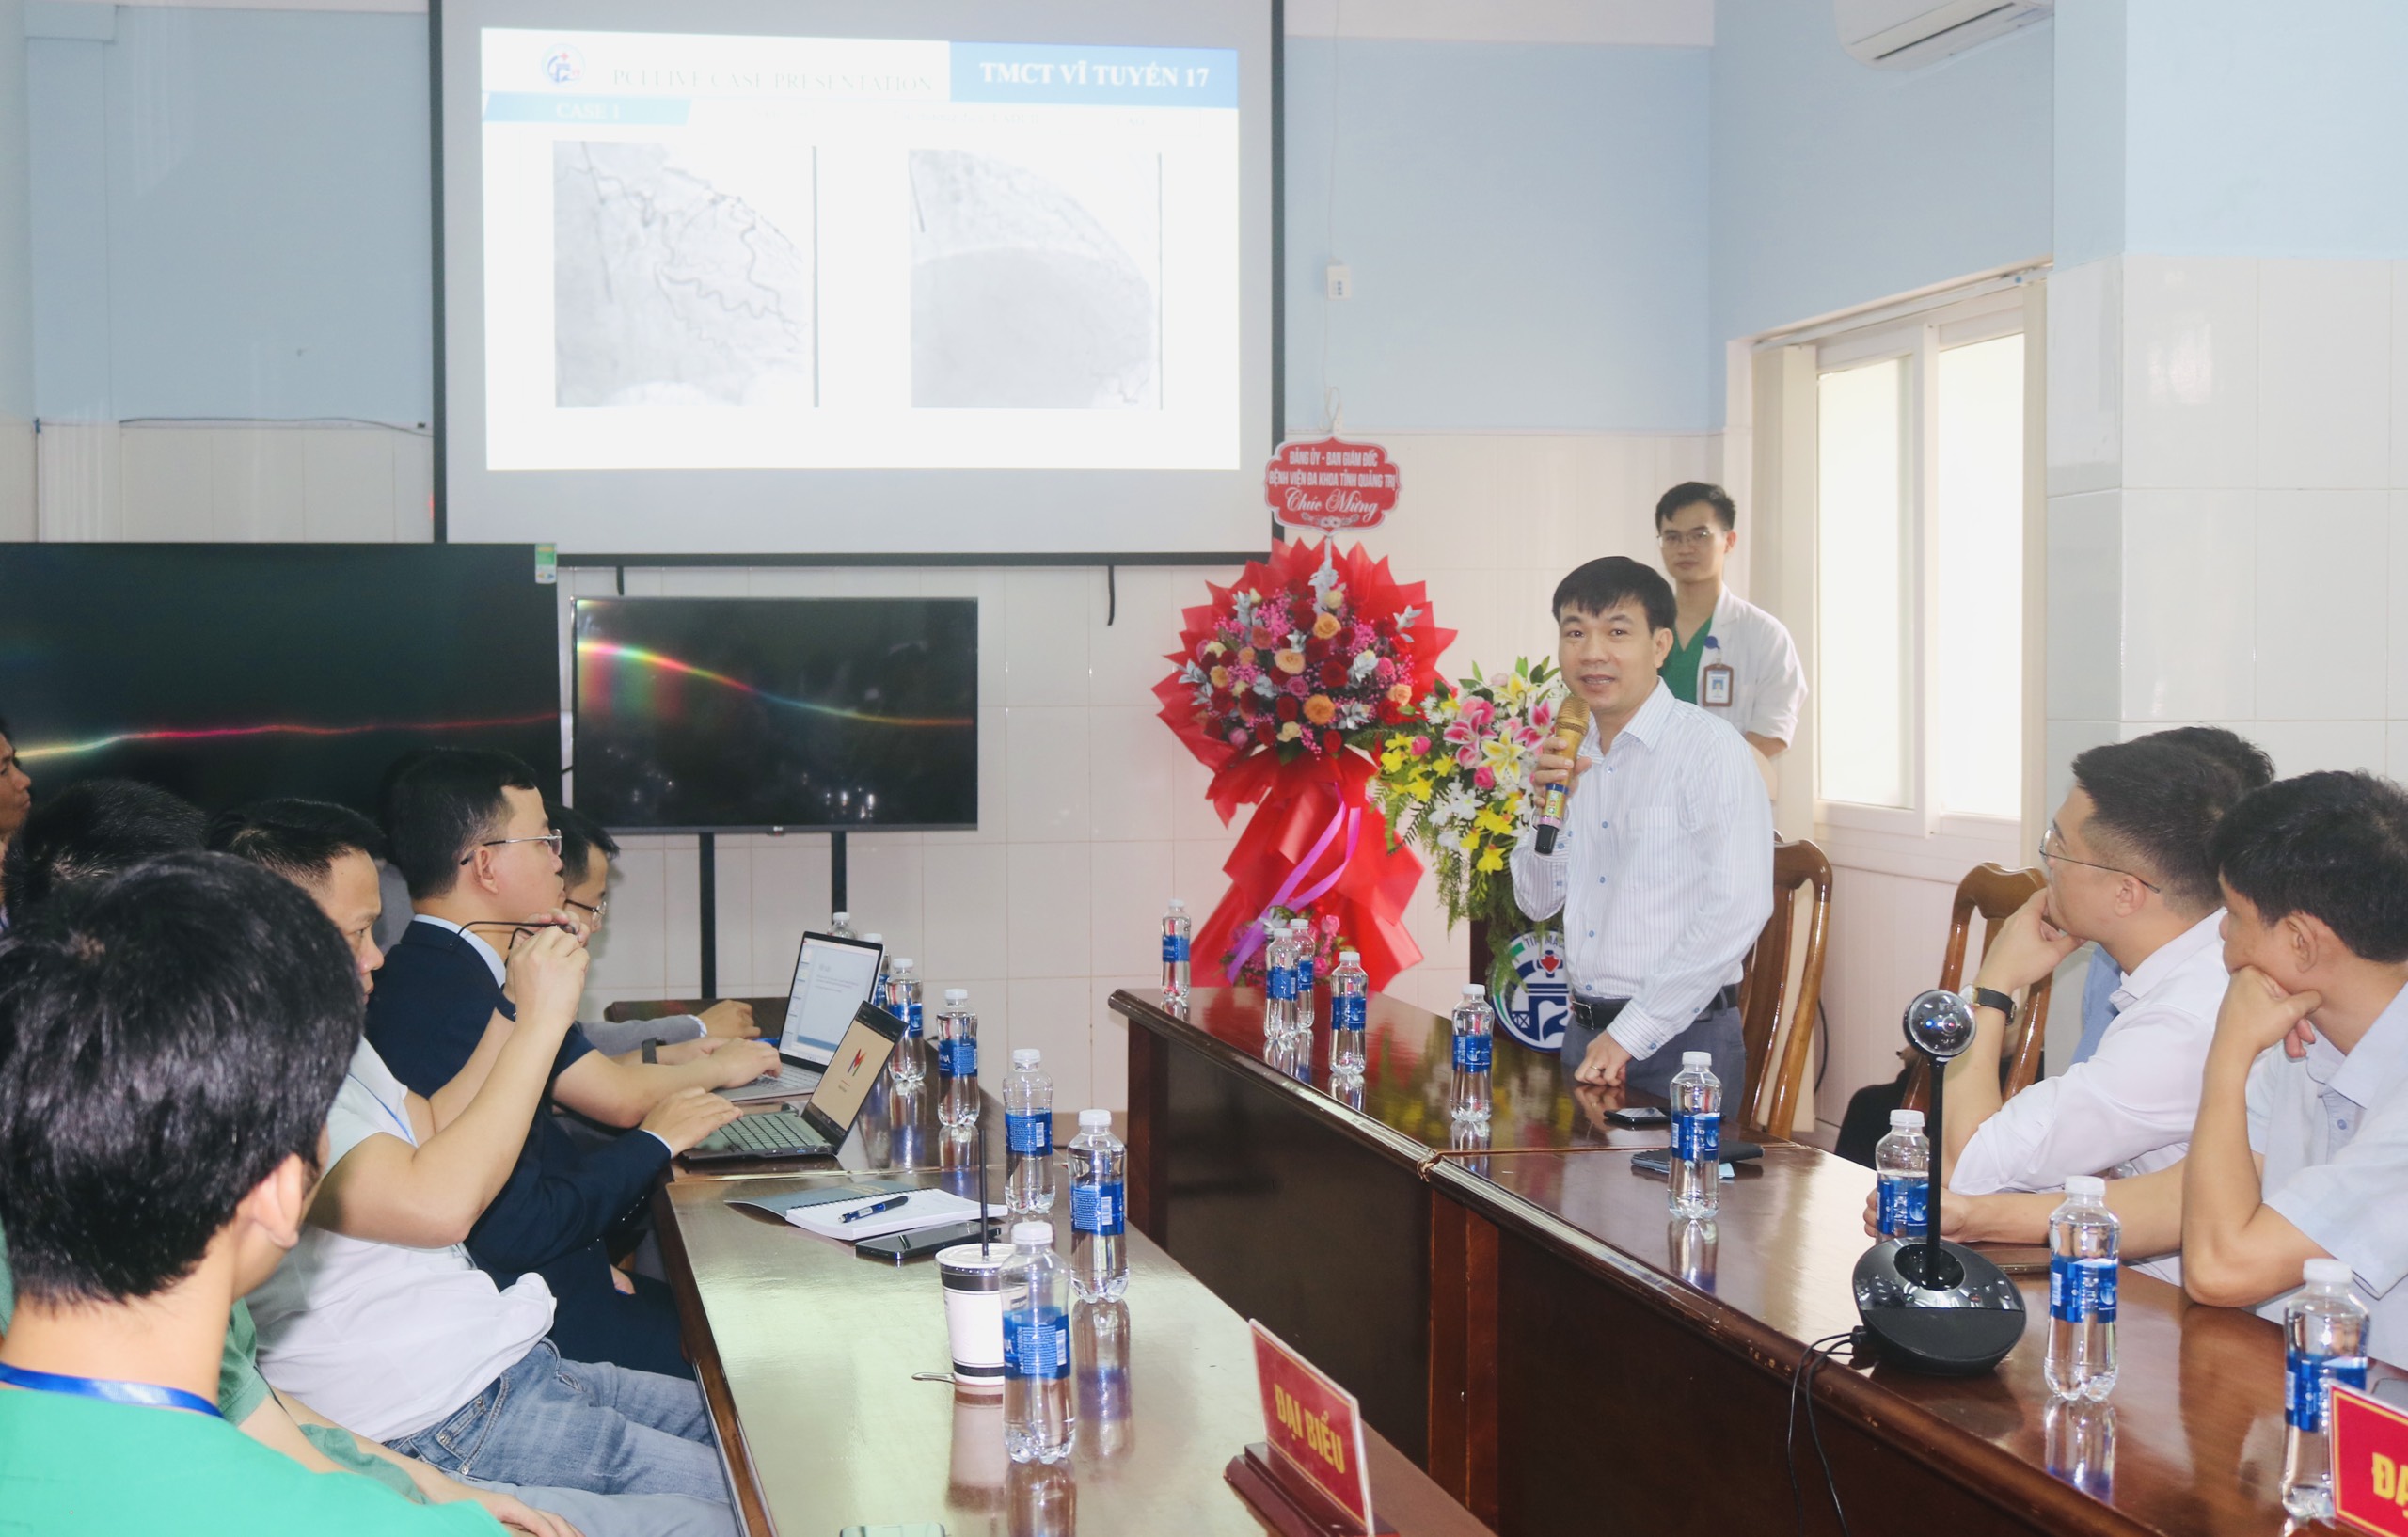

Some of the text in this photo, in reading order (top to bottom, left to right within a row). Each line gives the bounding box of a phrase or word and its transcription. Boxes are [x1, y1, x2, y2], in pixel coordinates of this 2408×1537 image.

[613, 69, 932, 92] PCI LIVE CASE PRESENTATION
[980, 62, 1054, 84] TMCT
[1060, 59, 1087, 85] VĨ
[1185, 68, 1210, 87] 17
[556, 103, 607, 119] CASE
[1290, 447, 1309, 465] ĐẢNG
[1326, 452, 1341, 466] BAN
[1318, 472, 1339, 486] KHOA
[1285, 486, 1378, 523] Chúc Mừng
[1274, 1383, 1345, 1474] ĐẠI BIỂU
